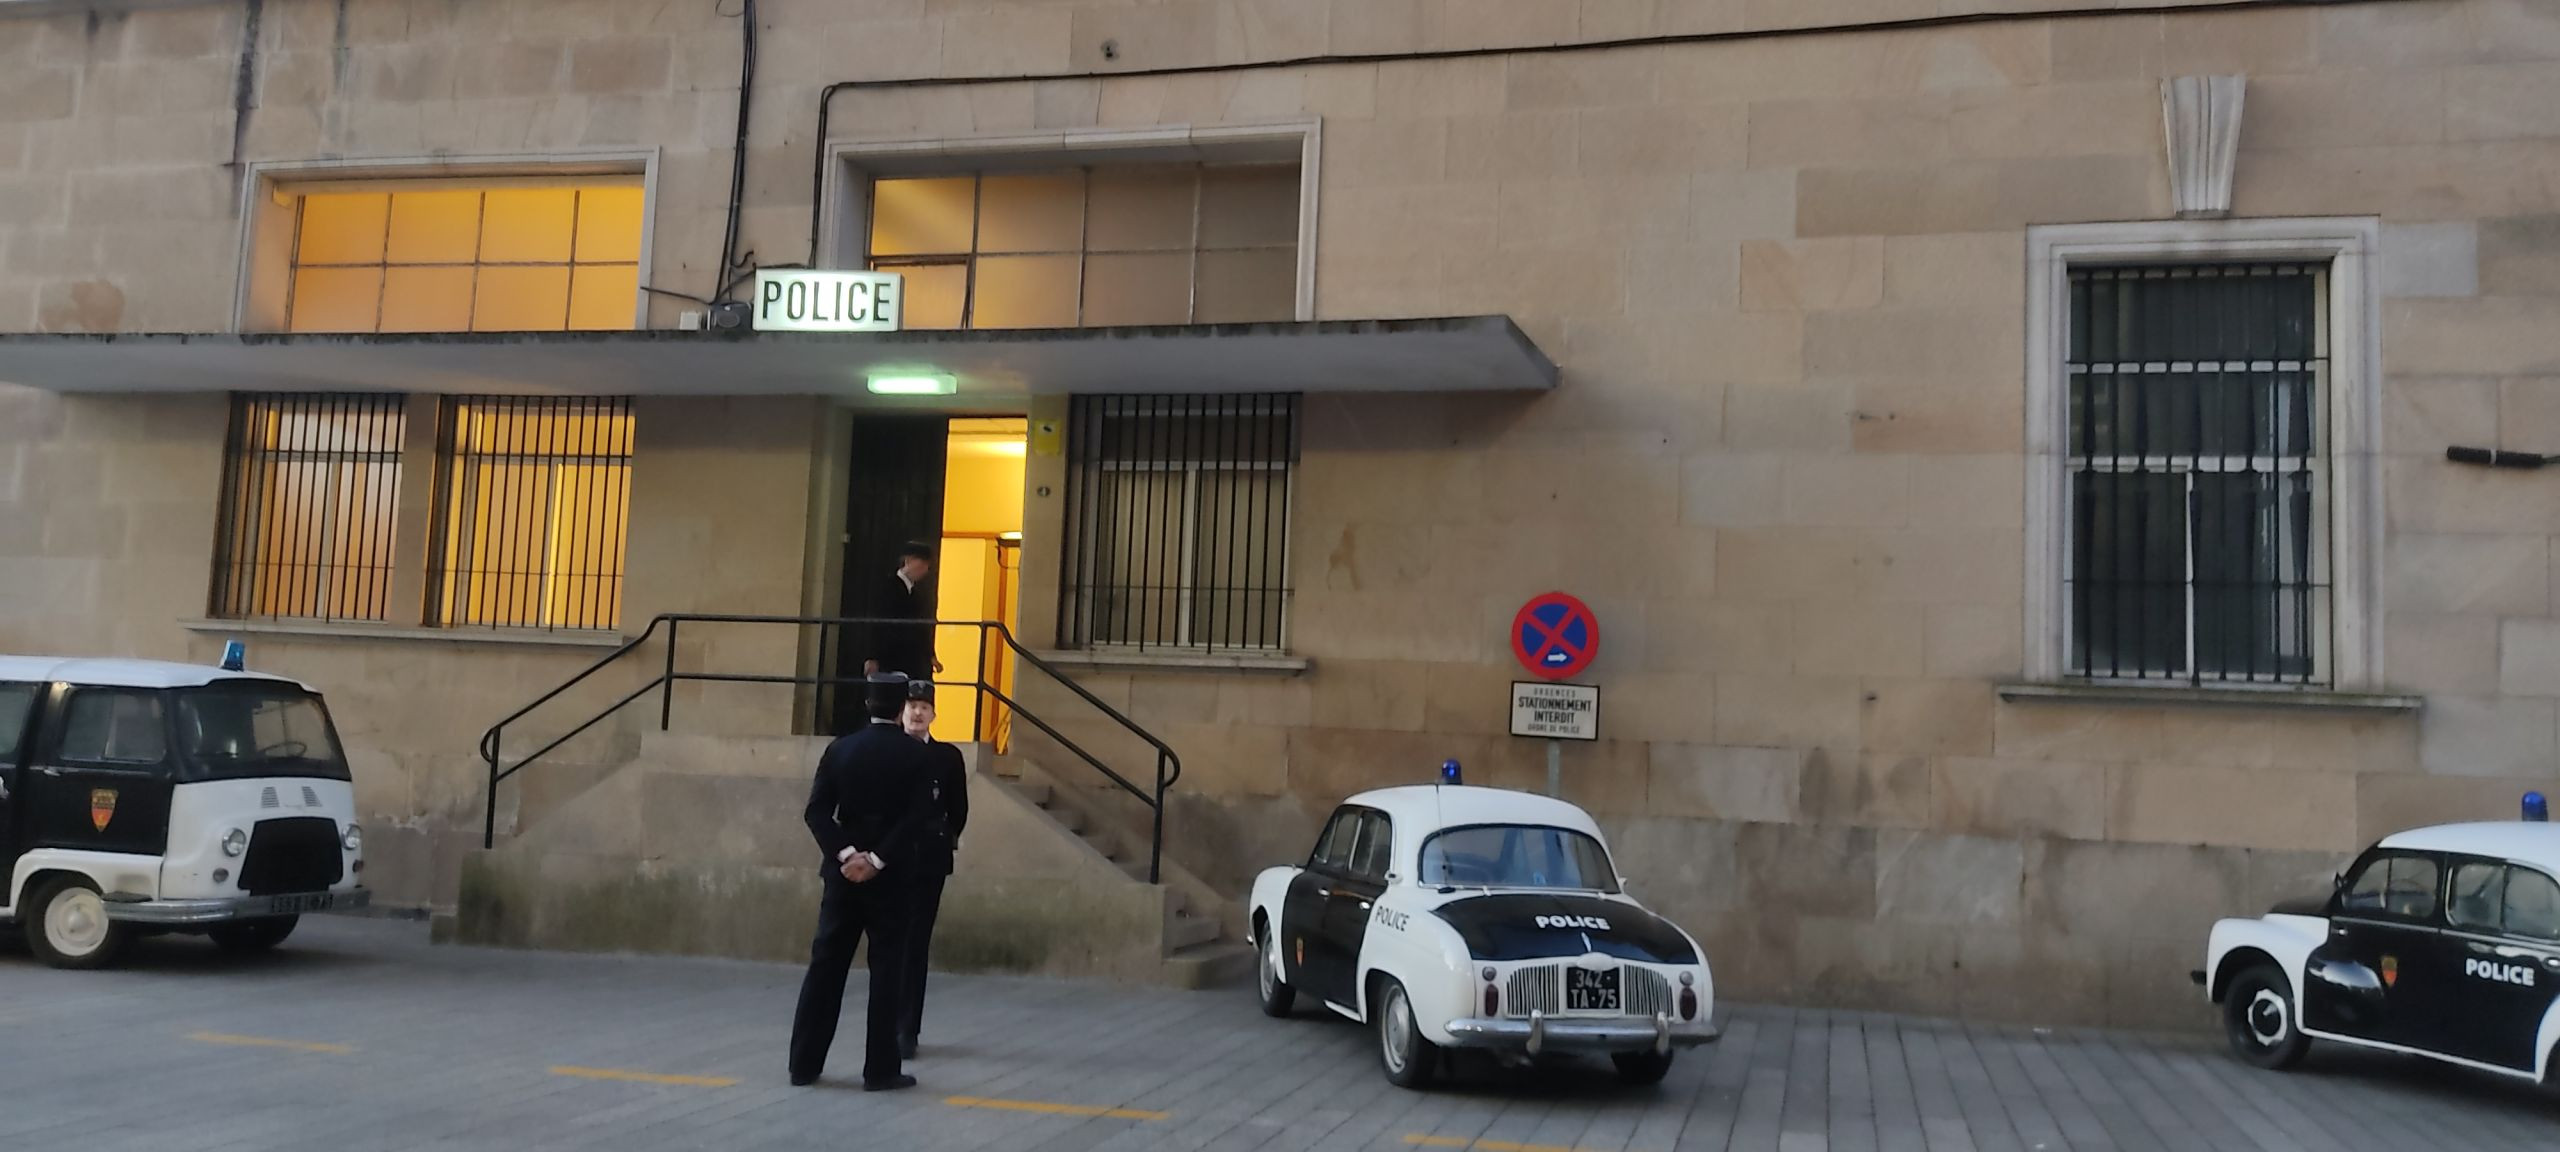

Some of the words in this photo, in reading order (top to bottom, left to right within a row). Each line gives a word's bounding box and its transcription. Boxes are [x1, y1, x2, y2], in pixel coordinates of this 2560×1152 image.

[762, 280, 891, 322] POLICE
[1518, 696, 1593, 712] STATIONNEMENT
[1533, 710, 1576, 724] INTERDIT
[1374, 905, 1411, 932] POLICE
[1535, 915, 1611, 930] POLICE
[2465, 957, 2535, 987] POLICE
